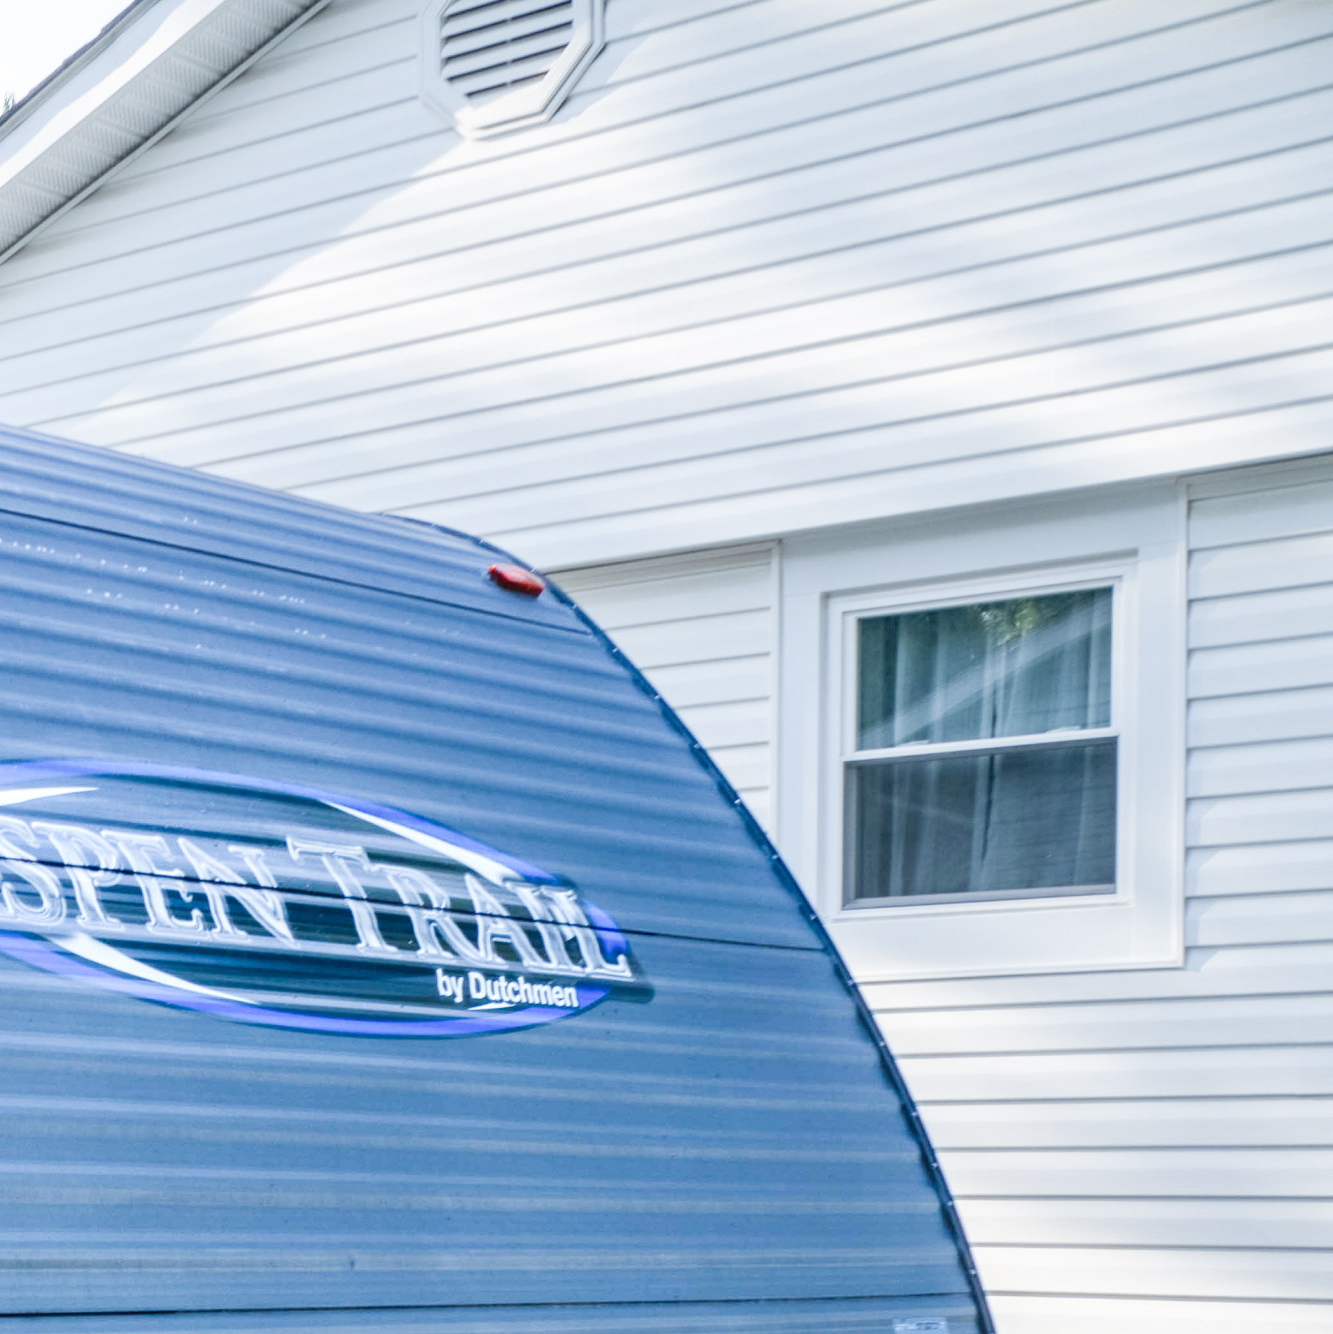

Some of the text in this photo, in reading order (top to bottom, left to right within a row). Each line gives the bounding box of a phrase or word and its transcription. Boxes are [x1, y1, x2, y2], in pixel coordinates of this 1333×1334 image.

[286, 836, 636, 982] TRAIL
[436, 968, 579, 1008] by Dutchmen
